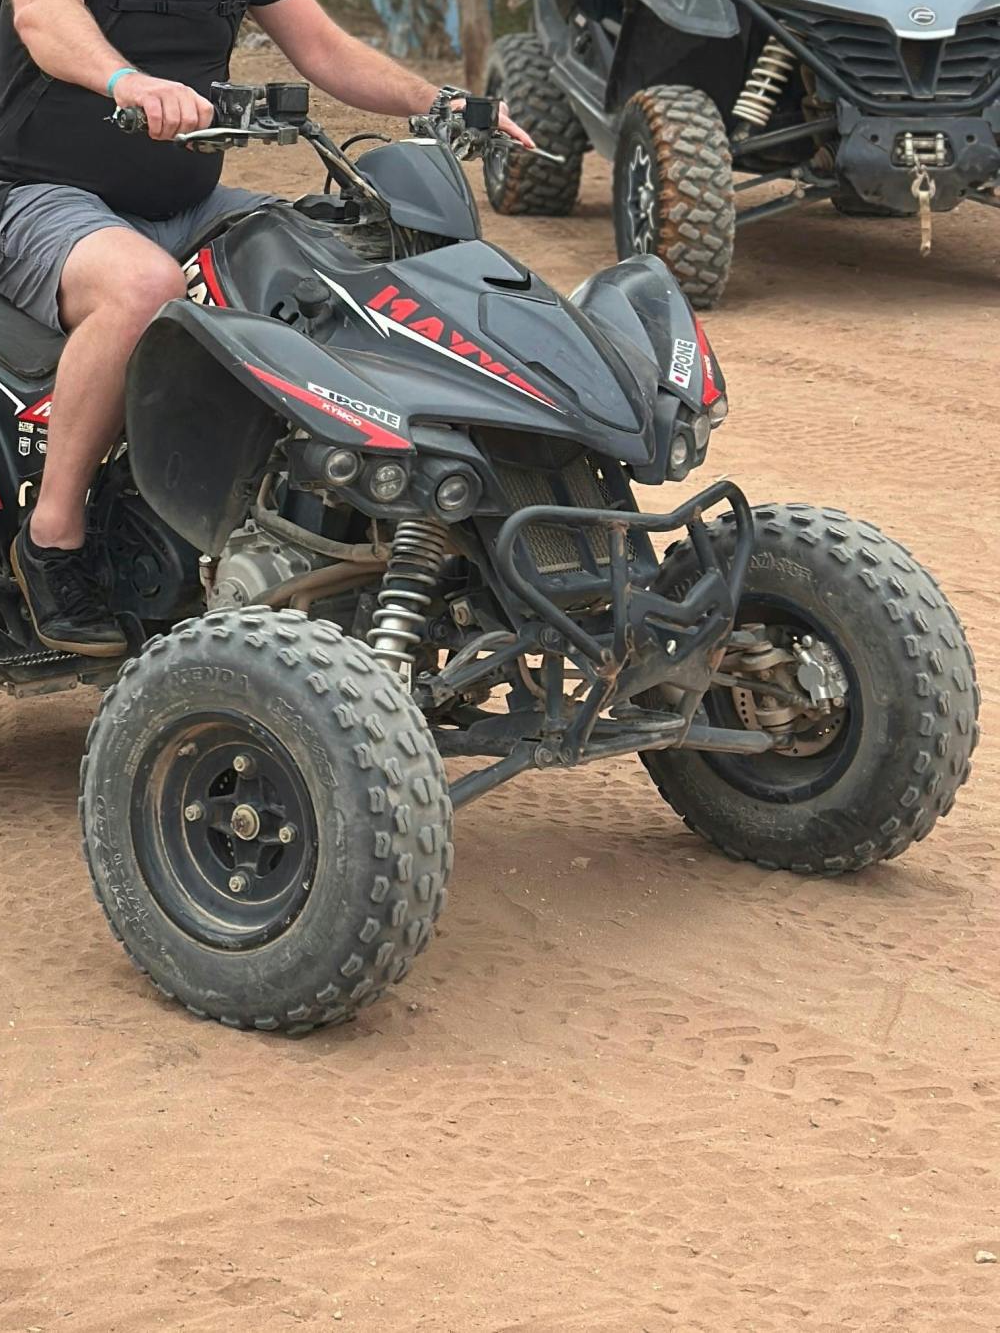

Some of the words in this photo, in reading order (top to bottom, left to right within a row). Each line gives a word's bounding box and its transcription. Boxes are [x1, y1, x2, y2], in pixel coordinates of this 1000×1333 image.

[672, 339, 694, 377] IPONE
[322, 402, 362, 426] KYMCO
[328, 392, 400, 428] IPONE
